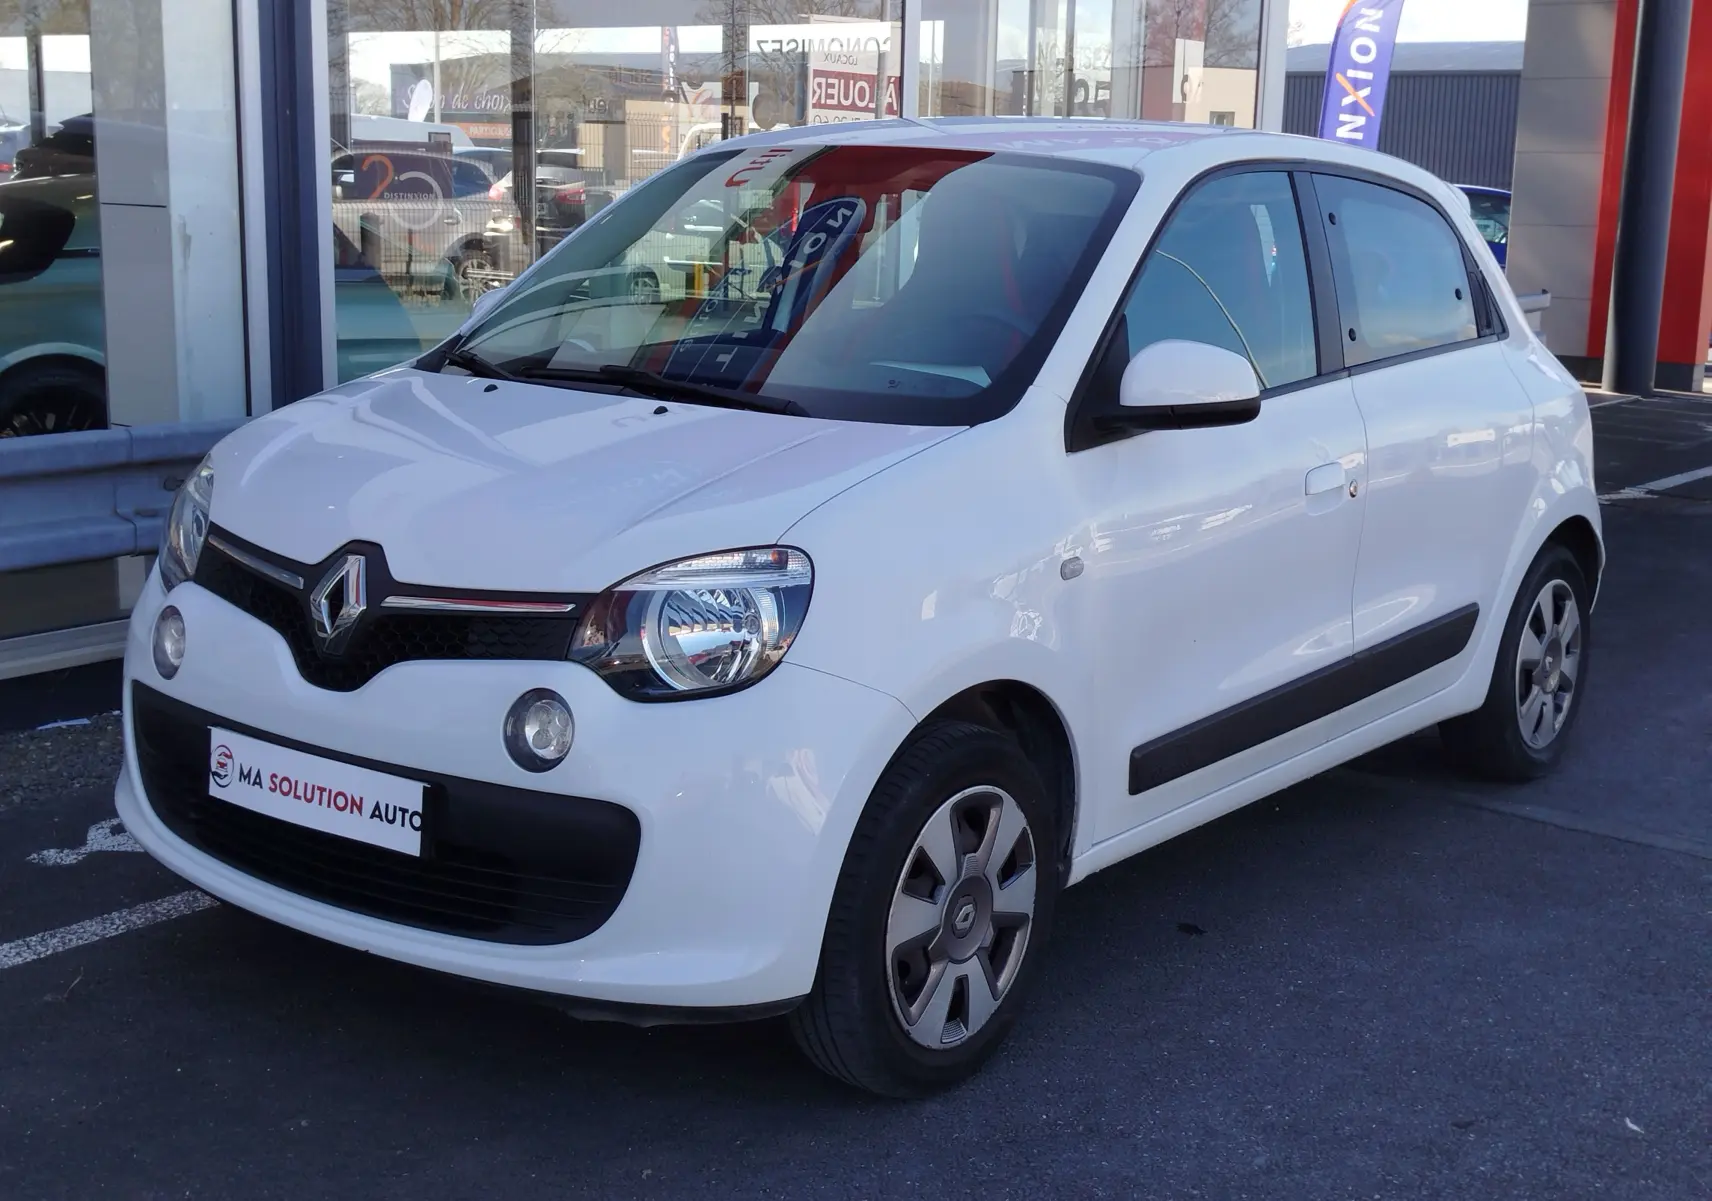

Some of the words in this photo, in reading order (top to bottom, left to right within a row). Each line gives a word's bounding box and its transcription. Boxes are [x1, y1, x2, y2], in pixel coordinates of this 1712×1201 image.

[238, 762, 264, 789] MA
[268, 772, 364, 817] SOLUTION
[369, 800, 423, 832] AUTO
